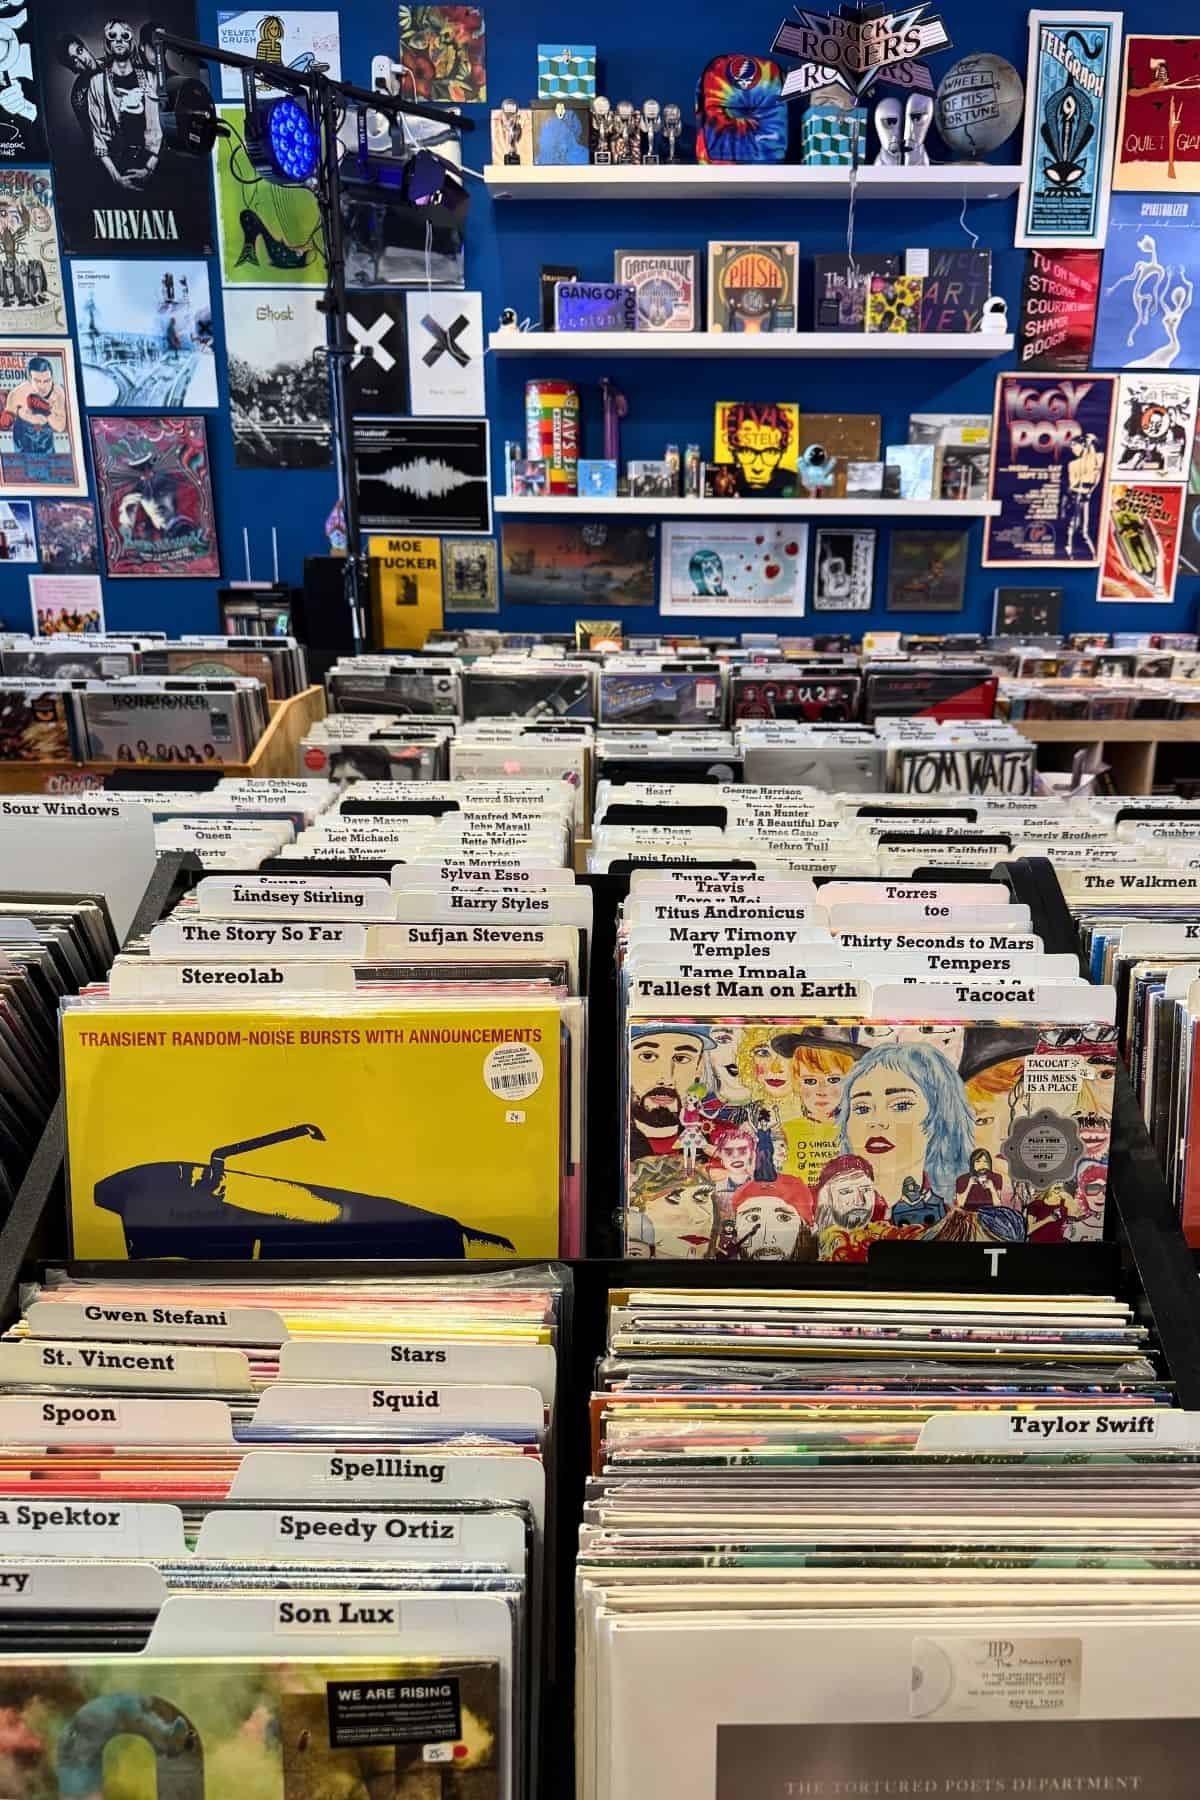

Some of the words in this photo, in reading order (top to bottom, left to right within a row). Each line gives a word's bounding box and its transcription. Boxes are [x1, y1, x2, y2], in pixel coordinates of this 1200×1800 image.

[221, 29, 257, 37] VELVET
[831, 16, 890, 43] BUCK
[801, 28, 921, 72] ROGERS
[1040, 29, 1105, 98] TELEGRAPH
[944, 72, 987, 90] WHEEL
[93, 209, 179, 240] NIRVANA
[1032, 250, 1051, 273] TV
[728, 255, 778, 288] PHISH
[560, 286, 602, 300] GANG
[604, 287, 623, 300] OF
[256, 306, 294, 321] Ghost
[1004, 381, 1094, 421] IGGY
[721, 406, 794, 432] ELVIS
[721, 432, 793, 446] COSTELLO
[1008, 419, 1081, 454] POP
[1125, 487, 1165, 507] RECORD
[1120, 499, 1153, 518] STORE
[388, 541, 422, 551] MOE
[379, 557, 437, 569] TUCKER
[904, 751, 961, 794] TOM
[965, 751, 1031, 796] WAITS
[231, 795, 254, 803] Pink
[257, 795, 287, 804] Floyd
[645, 787, 672, 796] Heart
[760, 787, 802, 797] Harrison
[2, 803, 40, 815] Sour
[44, 802, 121, 816] Windows
[463, 812, 508, 821] Manfred
[753, 809, 771, 818] Ian
[774, 809, 809, 818] Hunter
[736, 818, 755, 828] It's
[756, 818, 766, 828] A
[767, 818, 817, 829] Beautiful
[818, 819, 840, 829] Day
[195, 831, 232, 841] Queen
[328, 834, 347, 842] Lee
[350, 833, 399, 842] Michaels
[461, 837, 488, 847] Bette
[1152, 829, 1195, 840] Chubby
[768, 841, 802, 852] Jethro
[805, 841, 829, 852] Tull
[465, 859, 521, 867] Morrison
[788, 862, 838, 874] Journey
[441, 868, 491, 883] Sylvan
[495, 869, 530, 881] Esso
[1085, 876, 1115, 888] The
[1120, 876, 1198, 888] Walkmen
[695, 881, 746, 894] Travis
[886, 887, 938, 900] Torres
[233, 888, 298, 906] Lindsey
[303, 889, 364, 906] Stirling
[451, 896, 498, 912] Harry
[502, 896, 549, 911] Styles
[655, 906, 700, 919] Titus
[703, 906, 806, 920] Andronicus
[924, 904, 950, 917] toe
[182, 925, 223, 941] The
[227, 925, 277, 945] Story
[281, 926, 304, 941] So
[309, 927, 344, 942] Far
[408, 927, 469, 947] Sufjan
[473, 928, 545, 943] Stevens
[669, 927, 720, 942] Mary
[724, 927, 798, 943] Timony
[841, 934, 892, 951] Thirty
[896, 934, 966, 950] Seconds
[969, 936, 985, 950] to
[989, 936, 1035, 951] Mars
[693, 943, 771, 960] Temples
[680, 965, 734, 978] Tame
[738, 965, 808, 979] Impala
[927, 956, 1011, 974] Tempers
[182, 967, 284, 985] Stereolab
[638, 980, 712, 998] Tallest
[716, 981, 764, 998] Man
[770, 985, 796, 998] on
[801, 981, 858, 999] Earth
[956, 987, 1036, 1004] Tacocat
[79, 1031, 167, 1047] TRANSIENT
[172, 1029, 295, 1047] RANDOM-NOISE
[300, 1029, 361, 1046] BURSTS
[365, 1029, 404, 1045] WITH
[408, 1027, 543, 1045] ANNOUNCEMENTS
[1028, 1059, 1068, 1069] TACOCAT
[1027, 1074, 1049, 1083] THIS
[1051, 1074, 1077, 1083] MESS
[1027, 1083, 1038, 1093] IS
[1039, 1083, 1047, 1092] A
[1048, 1083, 1079, 1093] PLACE
[983, 1248, 1007, 1277] T
[85, 1306, 148, 1326] Gwen
[152, 1307, 228, 1327] Stefani
[43, 1348, 72, 1367] St.
[81, 1350, 175, 1372] Vincent
[391, 1345, 447, 1364] Stars
[372, 1390, 440, 1411] Squid
[42, 1404, 117, 1427] Spoon
[1010, 1415, 1091, 1437] Taylor
[1095, 1414, 1156, 1434] Swift
[330, 1457, 446, 1483] Spellling
[17, 1506, 121, 1528] Spektor
[280, 1515, 376, 1541] Speedy
[384, 1517, 455, 1540] Ortiz
[278, 1603, 333, 1623] Son
[339, 1603, 396, 1624] Lux
[338, 1689, 361, 1701] WE
[365, 1688, 396, 1700] ARE
[401, 1685, 453, 1698] RISING
[784, 1781, 823, 1795] THE
[831, 1779, 939, 1795] TORTURED
[946, 1777, 1006, 1793] POETS
[1013, 1776, 1143, 1792] DEPARTMENT
